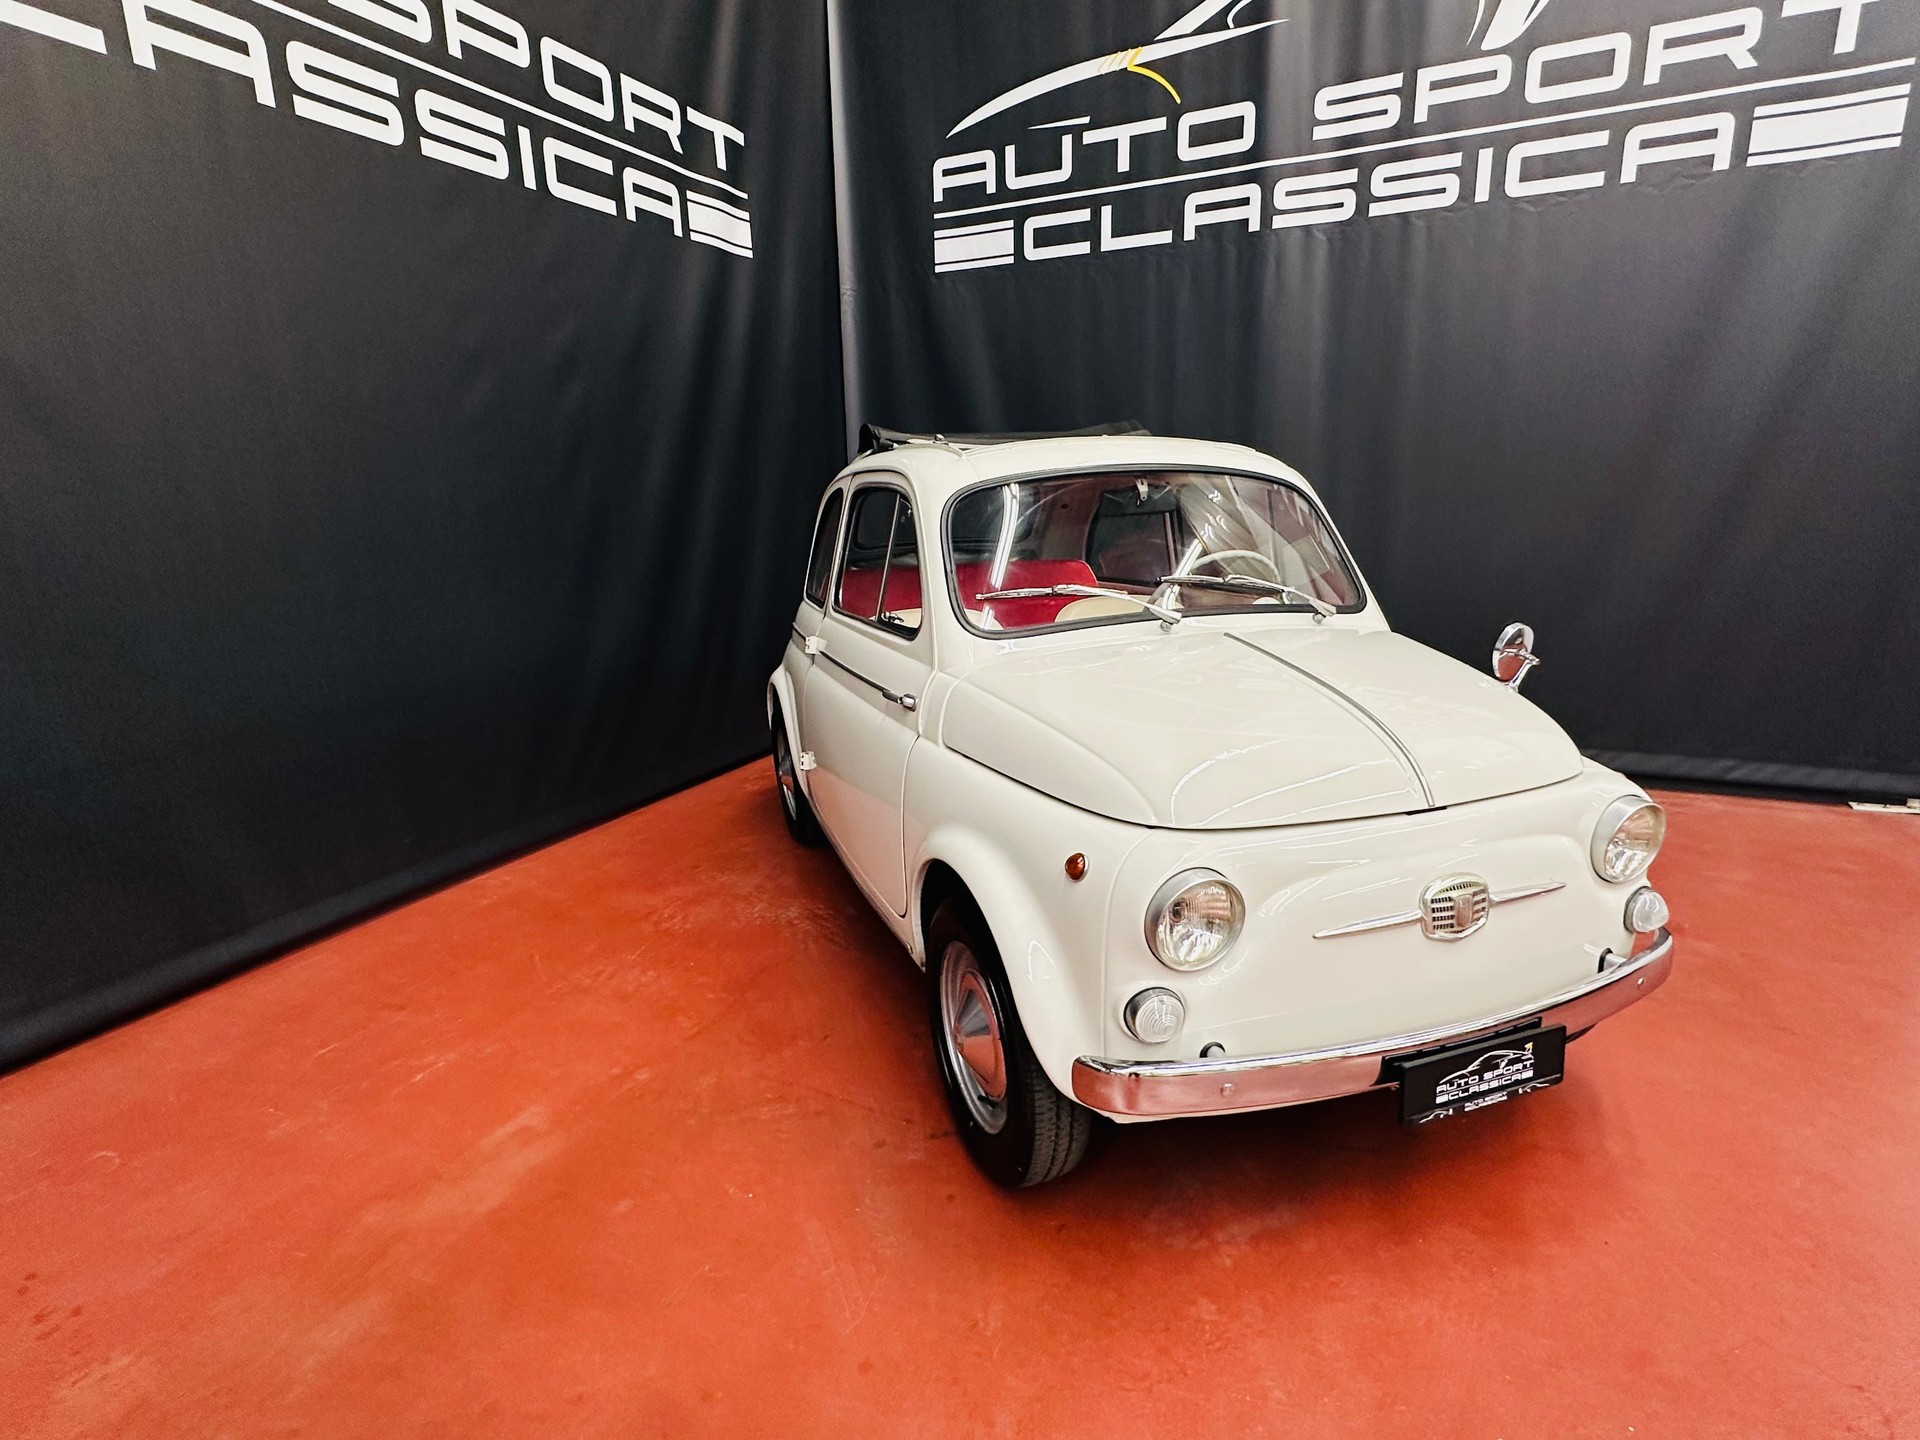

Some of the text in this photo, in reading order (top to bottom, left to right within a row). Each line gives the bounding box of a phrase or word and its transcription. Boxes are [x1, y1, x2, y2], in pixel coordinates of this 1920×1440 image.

[933, 0, 1880, 203] AUTO SPORT
[1023, 111, 1736, 261] CLASSICA
[1436, 1059, 1535, 1094] AUTO SPORT
[1448, 1073, 1522, 1101] CLASSICA
